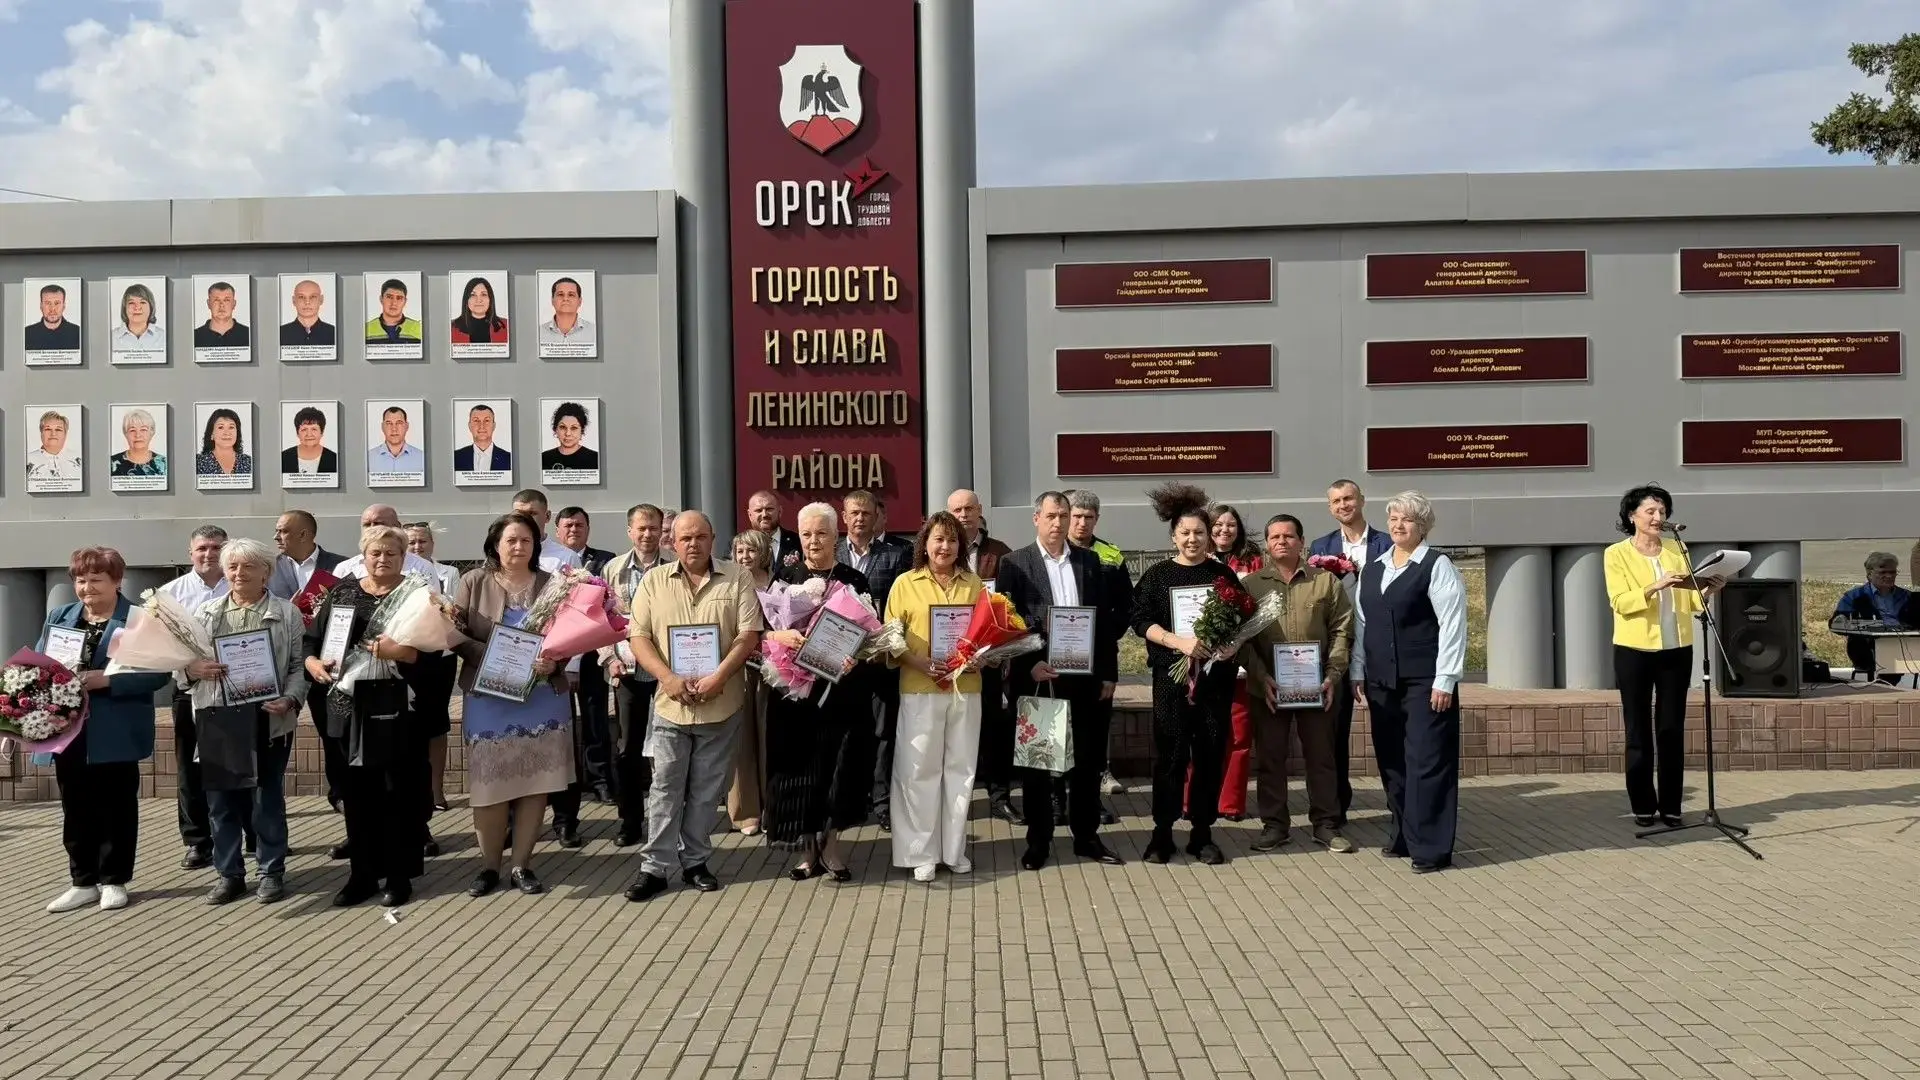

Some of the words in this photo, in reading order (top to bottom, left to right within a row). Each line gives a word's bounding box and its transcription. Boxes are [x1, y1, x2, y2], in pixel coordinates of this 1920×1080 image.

[870, 192, 890, 202] ГОРОД
[756, 180, 853, 227] ОРСК
[858, 204, 890, 215] ТРУДОВОЙ
[857, 217, 890, 227] ДОБЛЕСТИ
[1757, 251, 1823, 259] производственное
[1703, 261, 1733, 269] филиала
[1436, 269, 1483, 278] генеральный
[1485, 269, 1517, 277] директор
[1753, 268, 1822, 276] производственного
[1170, 278, 1202, 286] директор
[1425, 278, 1454, 286] Алпатов
[1455, 277, 1485, 285] Алексей
[1793, 277, 1835, 285] Валерьевич
[751, 266, 898, 306] ГОРДОСТЬ
[1158, 287, 1174, 295] Олег
[765, 330, 779, 364] И
[793, 328, 886, 364] СЛАВА
[1818, 345, 1856, 353] директора
[1104, 352, 1130, 360] Орский
[1461, 356, 1493, 364] директор
[1759, 355, 1792, 363] директор
[1793, 354, 1823, 362] филиала
[1131, 360, 1157, 368] филиал
[1772, 363, 1805, 371] Анатолий
[1806, 363, 1844, 371] Сергеевич
[1147, 368, 1179, 376] директор
[1461, 365, 1489, 373] Альберт
[1144, 377, 1169, 385] Сергей
[1170, 376, 1211, 384] Васильевич
[746, 390, 908, 427] ЛЕНИНСКОГО
[1752, 437, 1799, 446] генеральный
[1800, 437, 1833, 445] директор
[1461, 443, 1494, 451] директор
[1111, 454, 1147, 462] Курбатова
[1428, 451, 1464, 460] Панферов
[1490, 451, 1528, 459] Сергеевич
[772, 449, 883, 490] РАЙОНА
